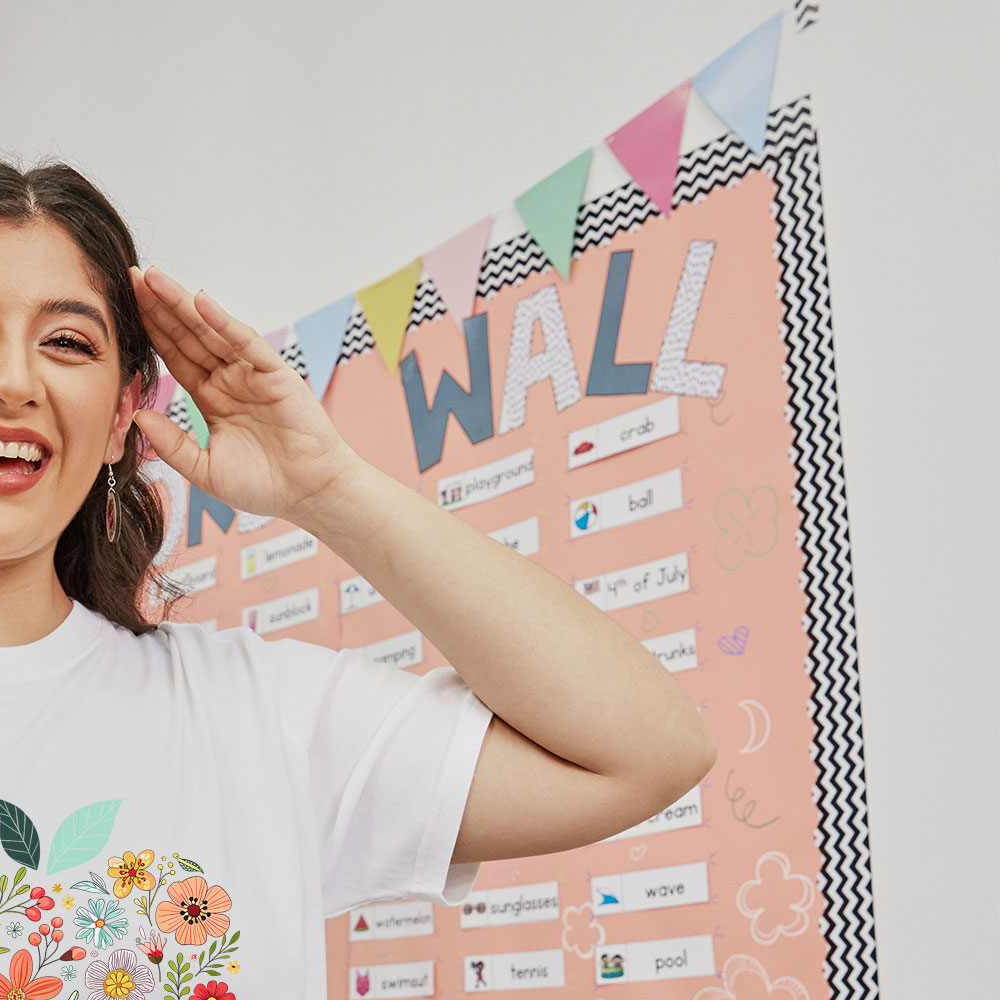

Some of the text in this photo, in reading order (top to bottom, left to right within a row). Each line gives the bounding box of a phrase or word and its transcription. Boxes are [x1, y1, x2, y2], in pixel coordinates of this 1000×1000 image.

[399, 240, 727, 473] WALL
[619, 415, 655, 442] crab
[465, 454, 535, 495] playground
[628, 488, 654, 512] ball
[633, 572, 651, 593] of
[656, 563, 688, 586] July
[644, 882, 685, 899] wave
[490, 894, 559, 917] sunglasses
[375, 912, 433, 929] watermelon
[510, 962, 549, 981] tennis
[655, 948, 688, 974] pool
